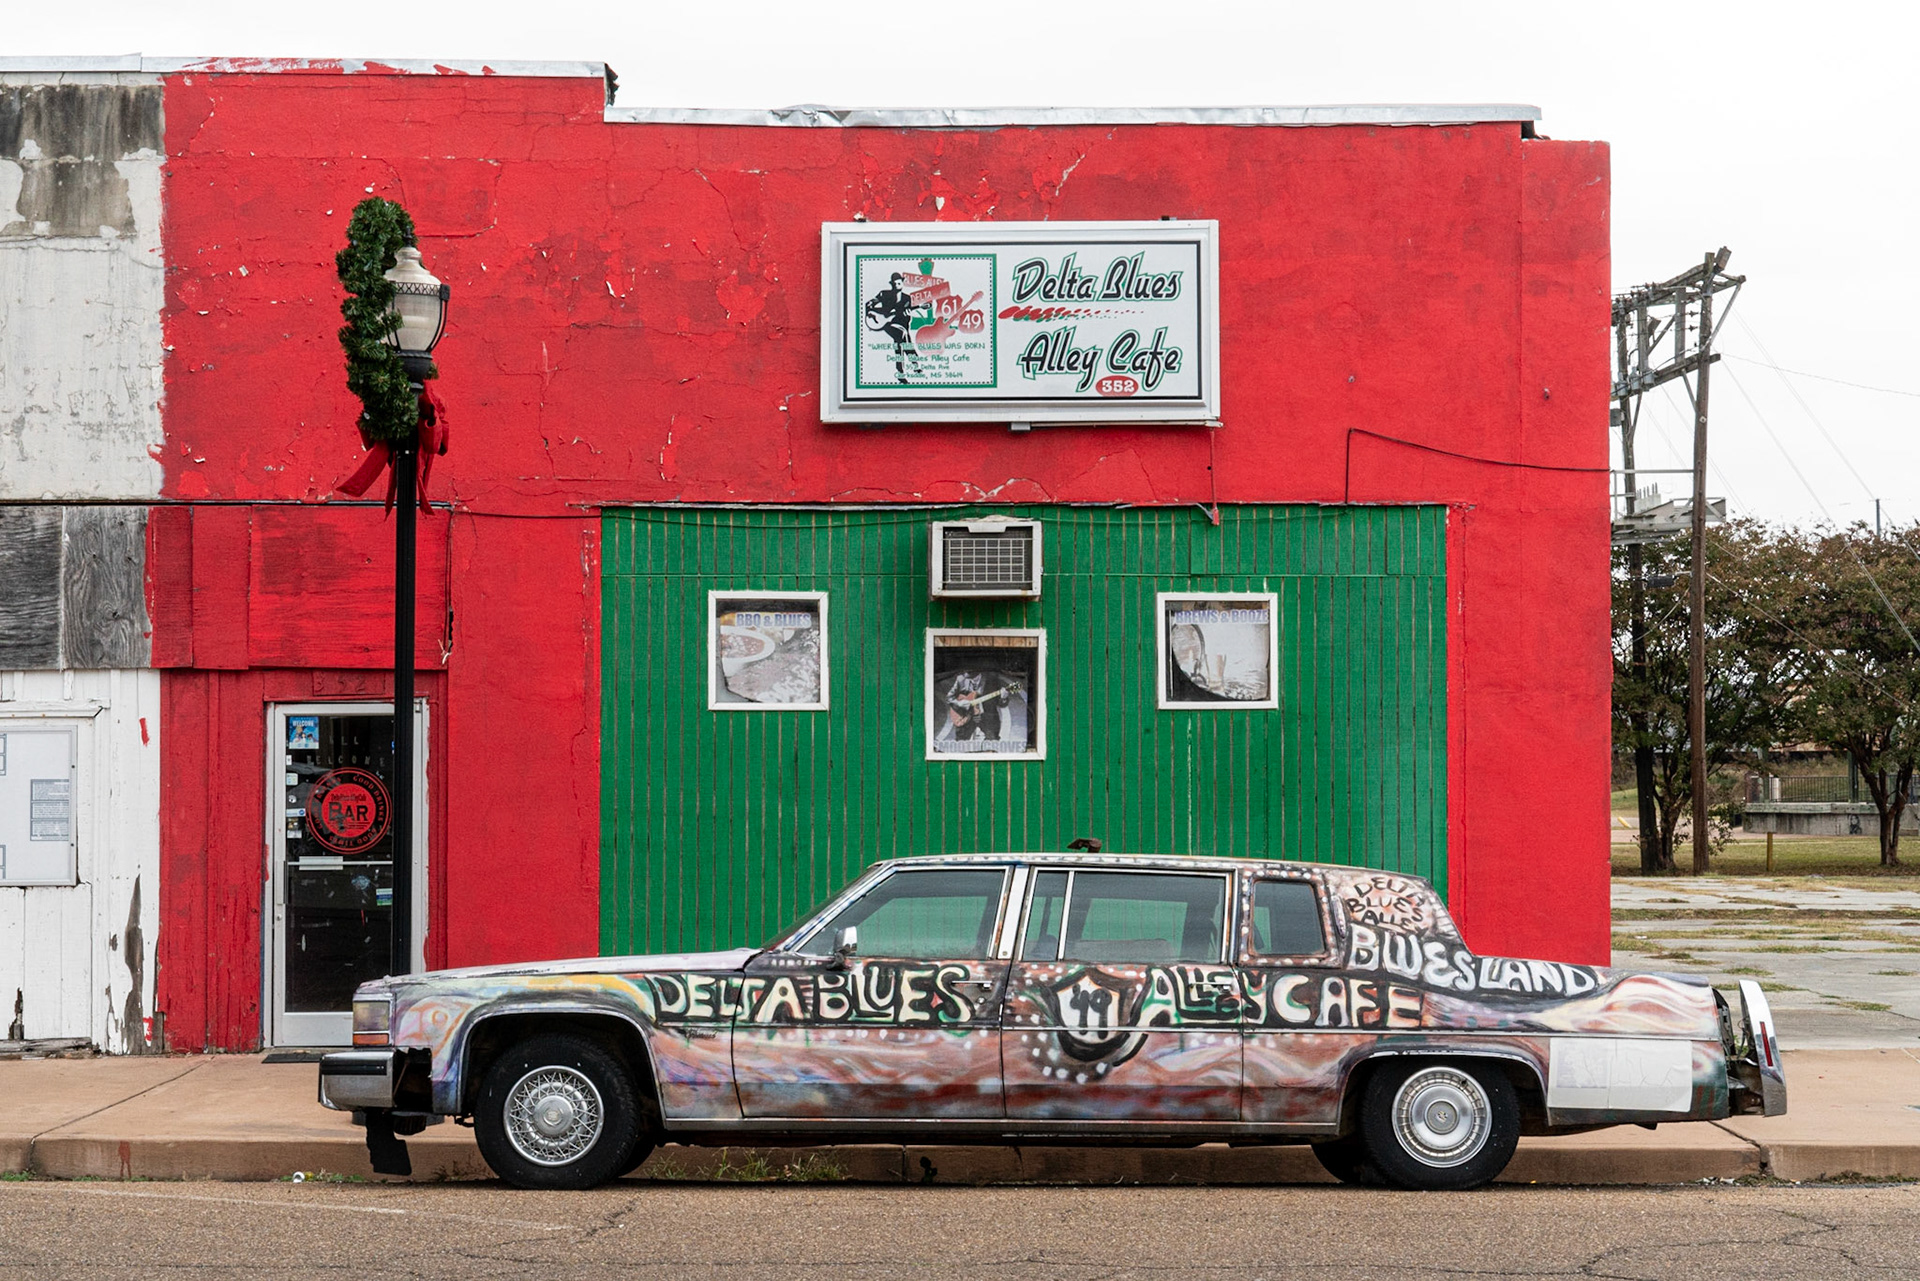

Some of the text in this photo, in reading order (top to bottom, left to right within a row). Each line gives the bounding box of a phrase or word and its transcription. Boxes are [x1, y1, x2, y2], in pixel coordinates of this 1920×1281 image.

[1014, 253, 1181, 302] Delta Blues
[941, 299, 958, 316] 61
[962, 313, 981, 329] 49
[887, 354, 970, 364] Delta Blues Alley Cafe
[1018, 328, 1181, 391] Alley Cafe
[1101, 380, 1135, 393] 352
[736, 613, 812, 627] BBQ & BLUES
[1175, 610, 1268, 623] BREWS & BOOZE
[328, 802, 369, 821] BAR
[1346, 897, 1424, 922] BLUES
[1360, 909, 1429, 936] ALLEY
[645, 962, 972, 1022] DELTA BLUES
